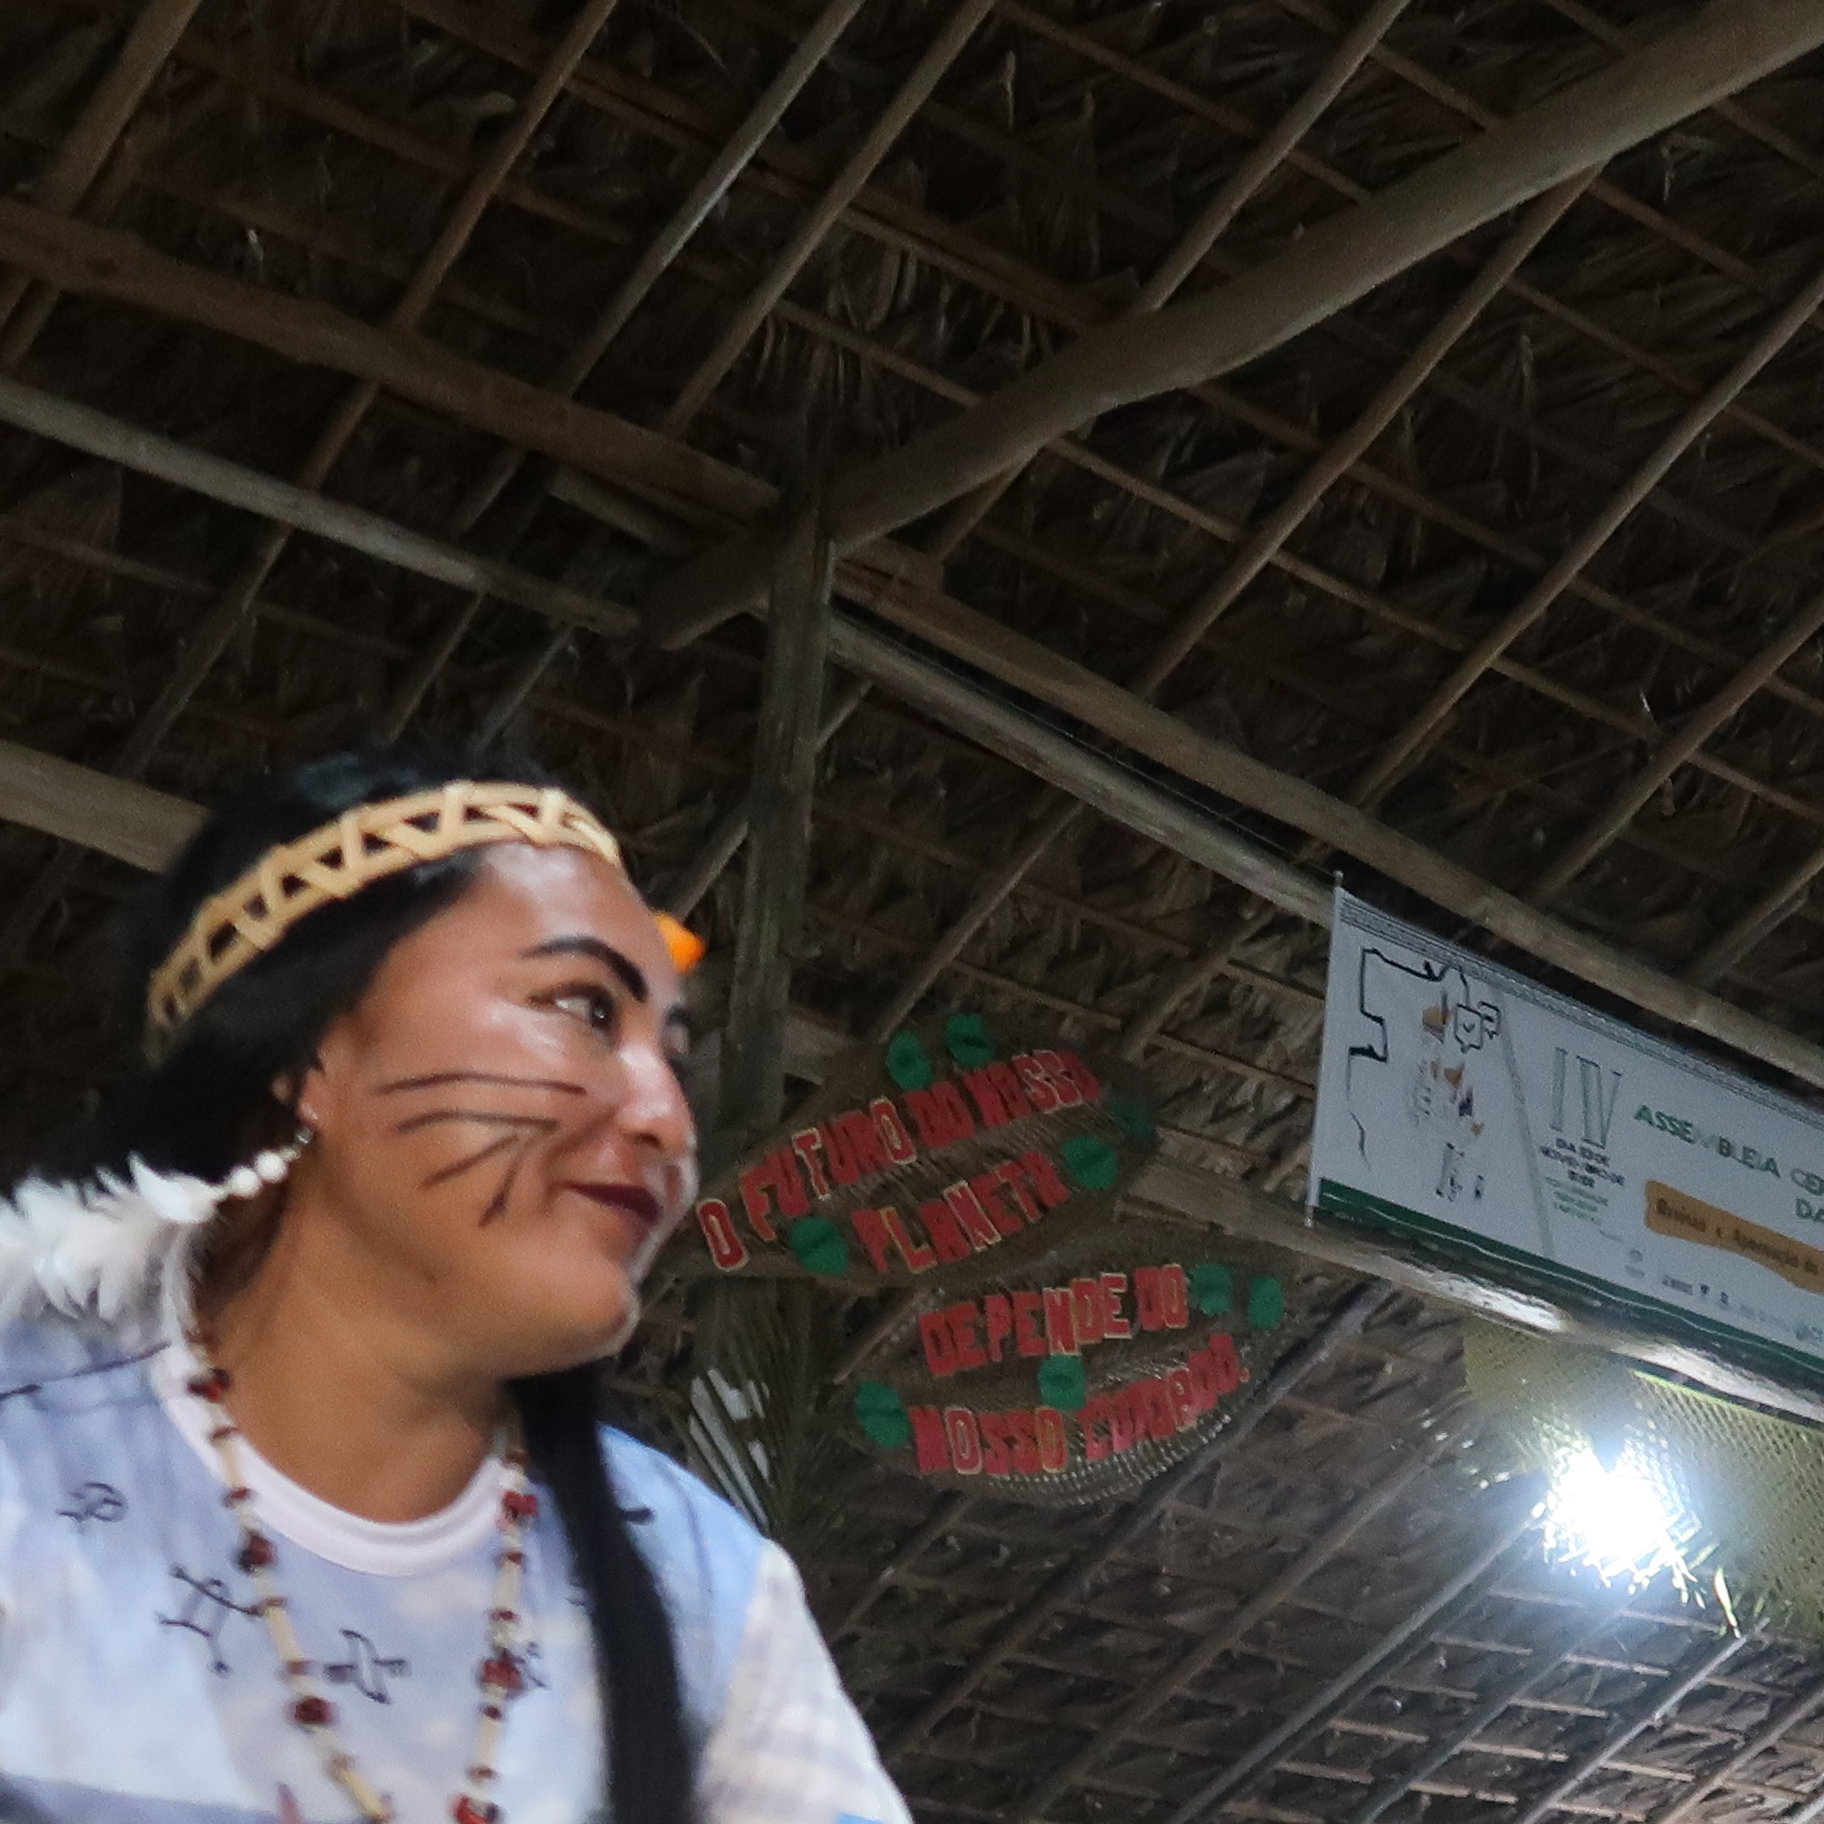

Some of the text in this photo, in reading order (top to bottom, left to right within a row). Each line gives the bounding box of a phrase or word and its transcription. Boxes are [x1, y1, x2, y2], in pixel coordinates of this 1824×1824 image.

[1550, 1047, 1622, 1149] IV
[1633, 1104, 1781, 1178] ASSEMBLEIA
[696, 1050, 1103, 1272] O FUTURO DO NOSSO
[851, 1150, 1070, 1274] PLANETA
[918, 1263, 1189, 1377] DEPENDE DO
[909, 1405, 1070, 1475] NOSSO
